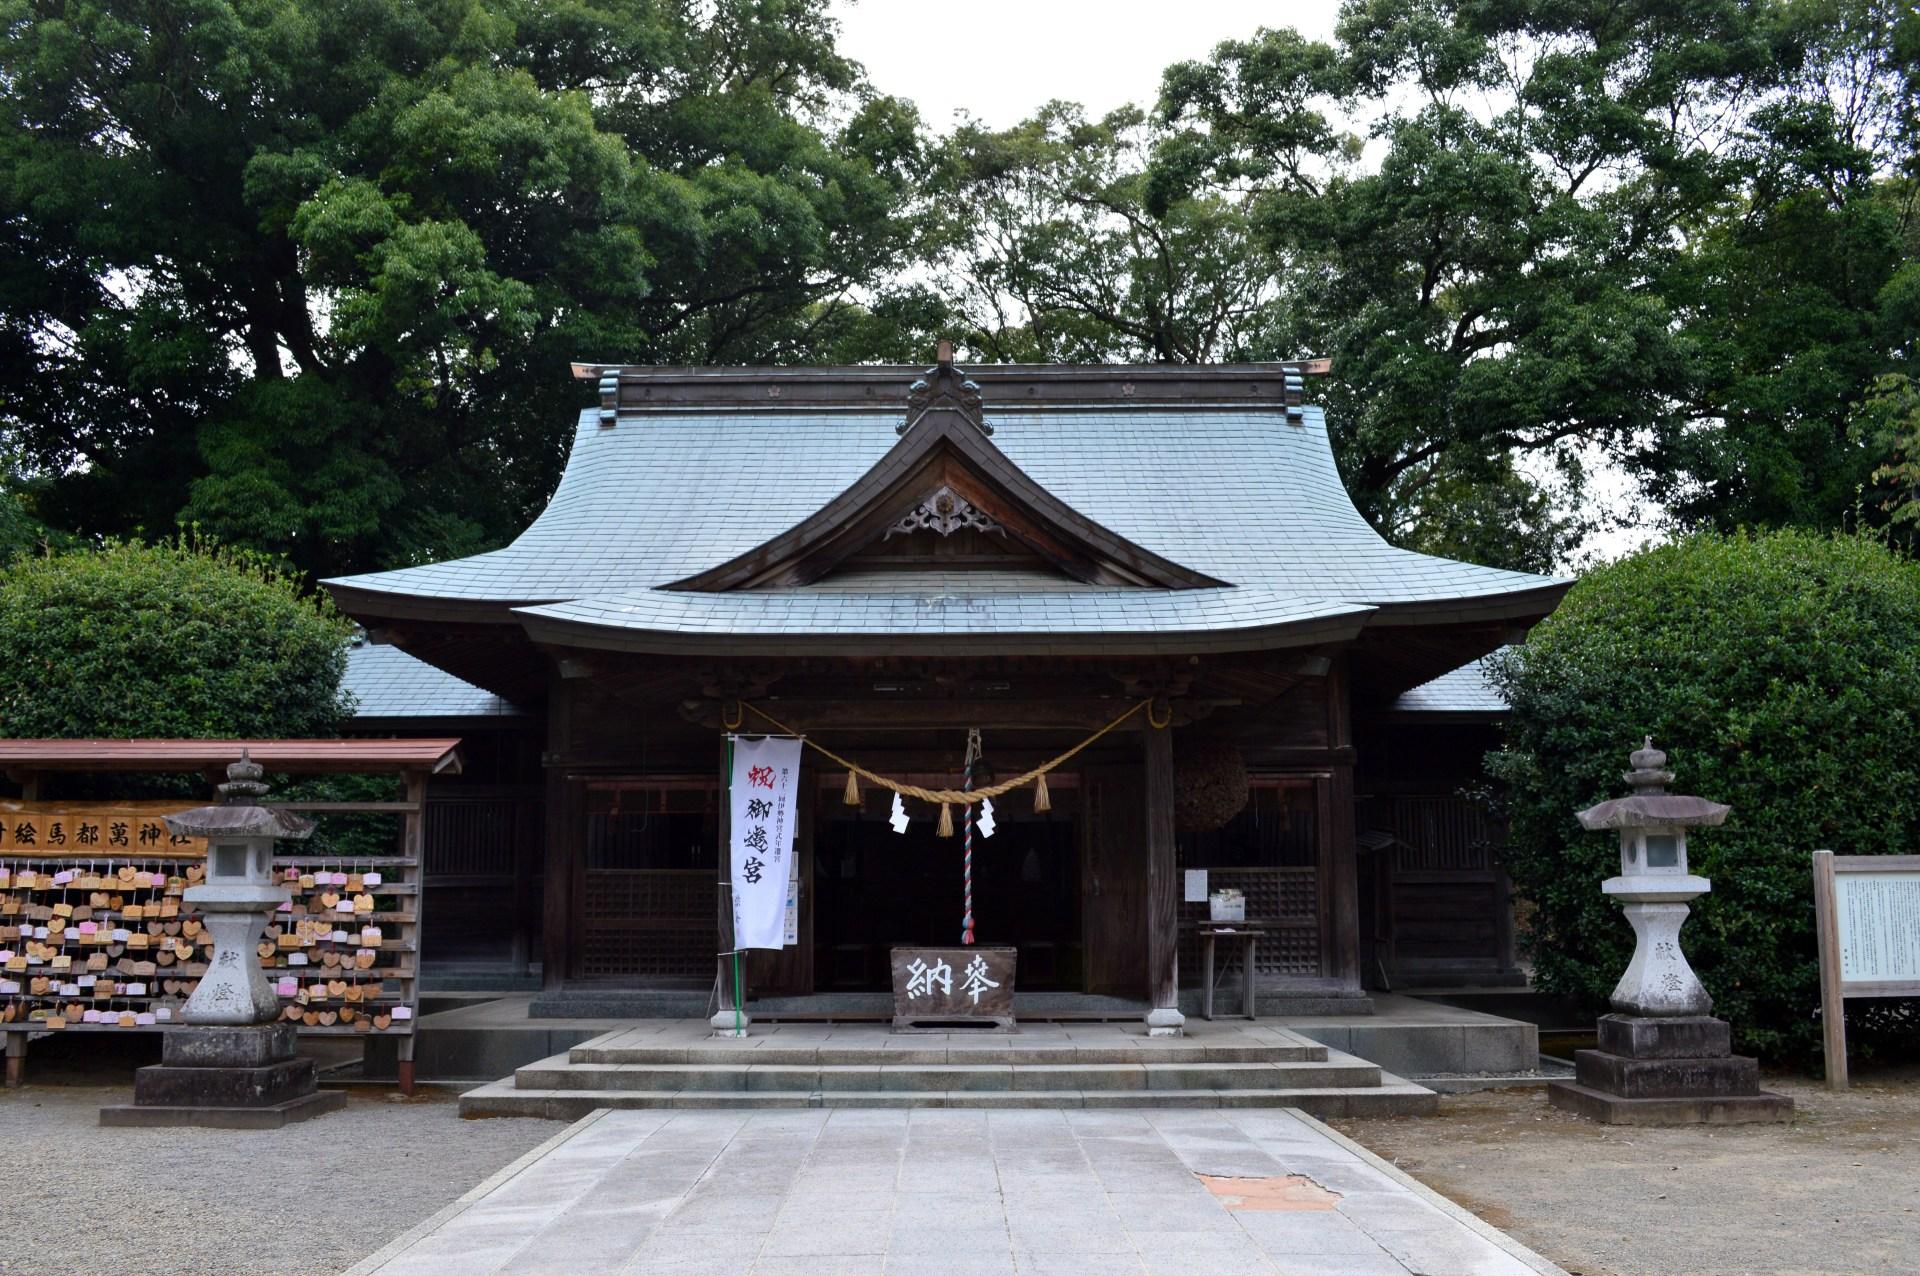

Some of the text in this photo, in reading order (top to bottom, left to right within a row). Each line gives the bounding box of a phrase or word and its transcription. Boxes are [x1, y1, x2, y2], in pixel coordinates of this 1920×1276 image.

[0, 822, 192, 847] 絵馬都萬神社
